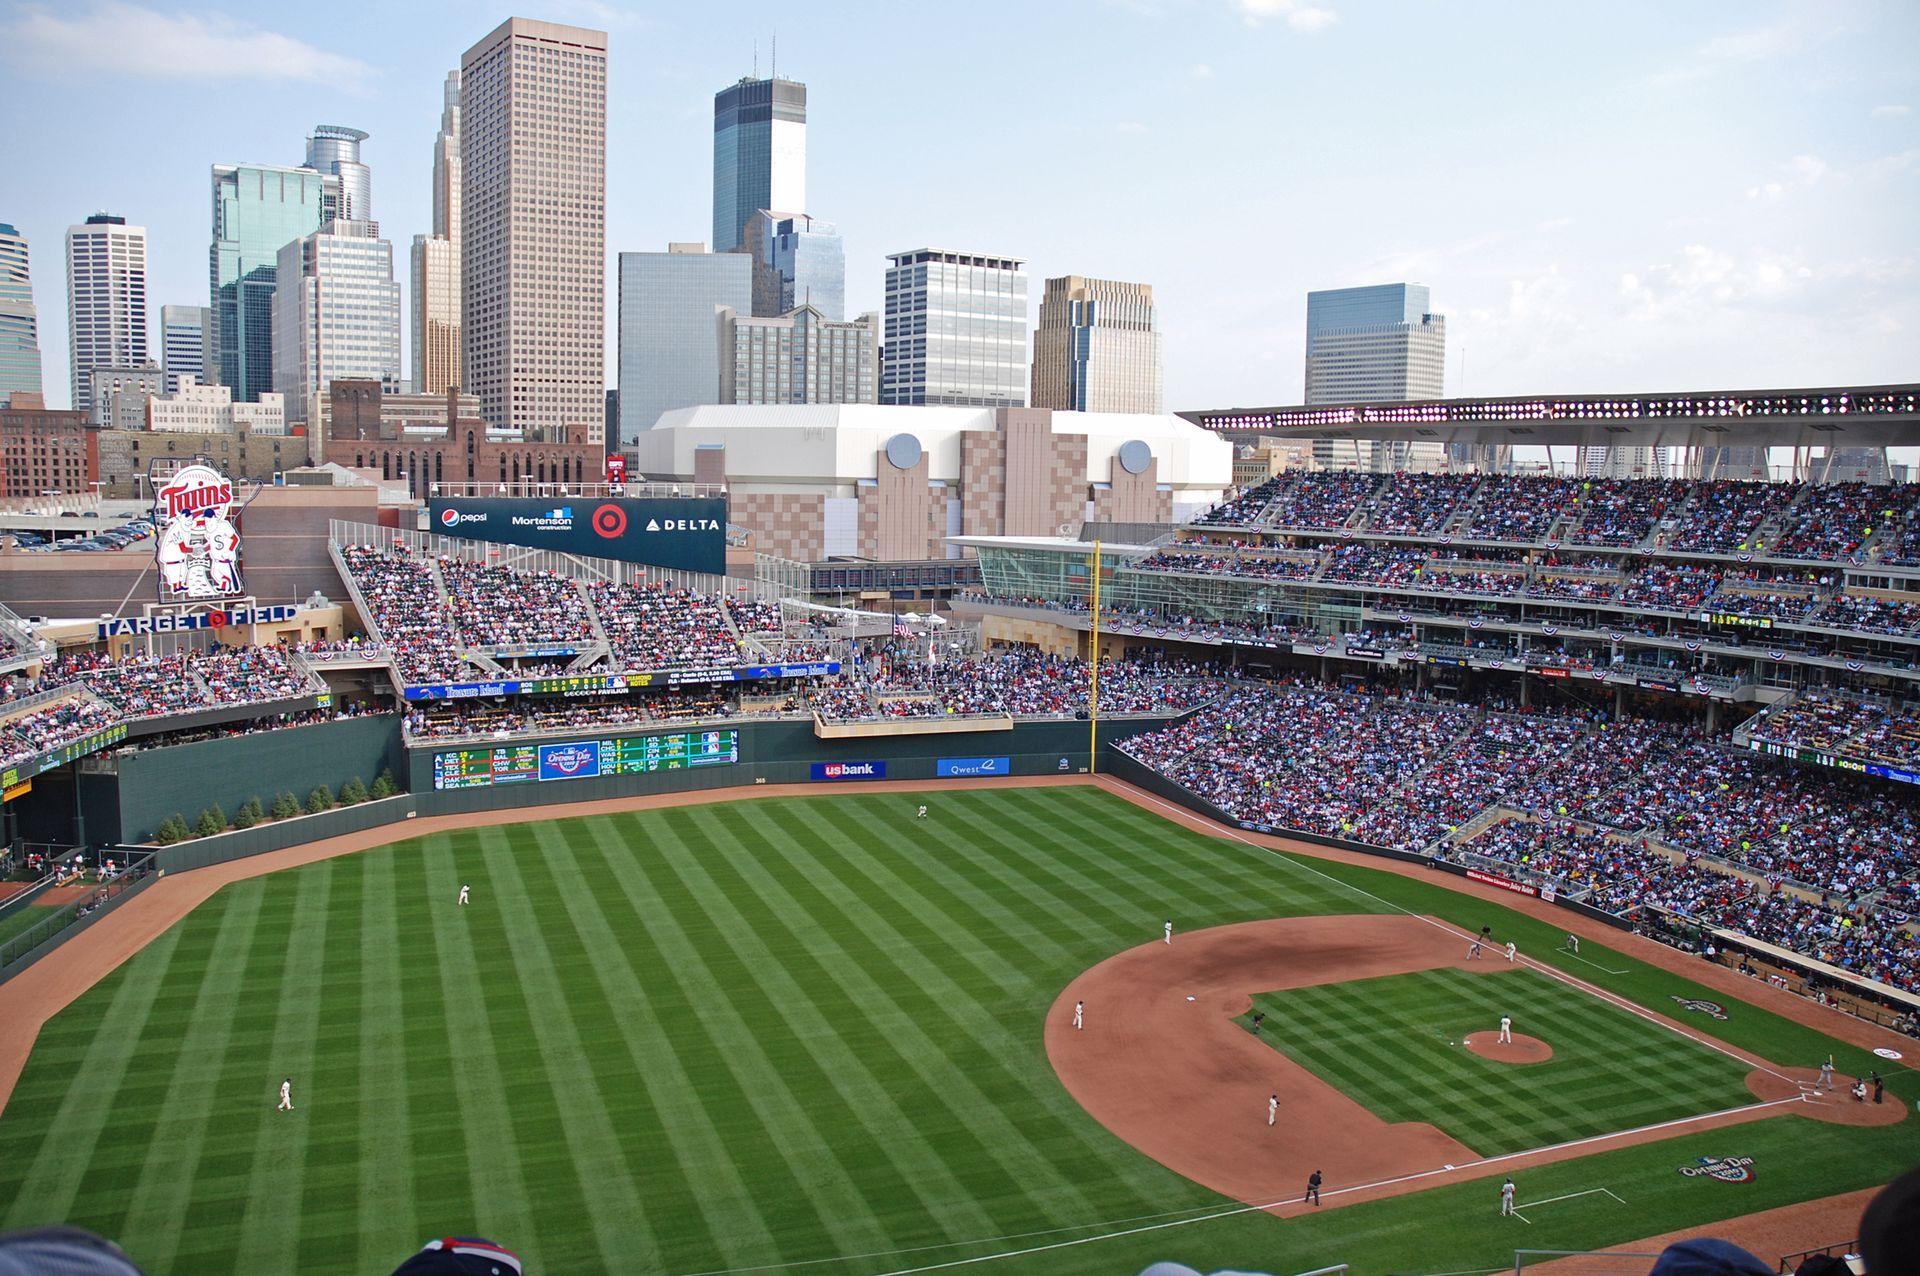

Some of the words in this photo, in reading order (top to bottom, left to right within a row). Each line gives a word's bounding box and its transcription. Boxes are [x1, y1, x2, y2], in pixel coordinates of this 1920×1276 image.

[161, 482, 231, 518] Twins
[460, 513, 487, 523] pepsi
[512, 516, 572, 525] Mortenson
[664, 519, 720, 531] DELTA
[214, 534, 225, 550] S
[103, 612, 206, 636] TARGET
[231, 606, 297, 626] FIELD
[780, 667, 807, 677] Treasure
[808, 664, 829, 675] Island
[445, 686, 478, 698] Treasure
[479, 683, 505, 696] Island
[950, 765, 979, 775] Qwest
[1678, 1162, 1730, 1177] OPENING
[1723, 1157, 1754, 1168] DAY
